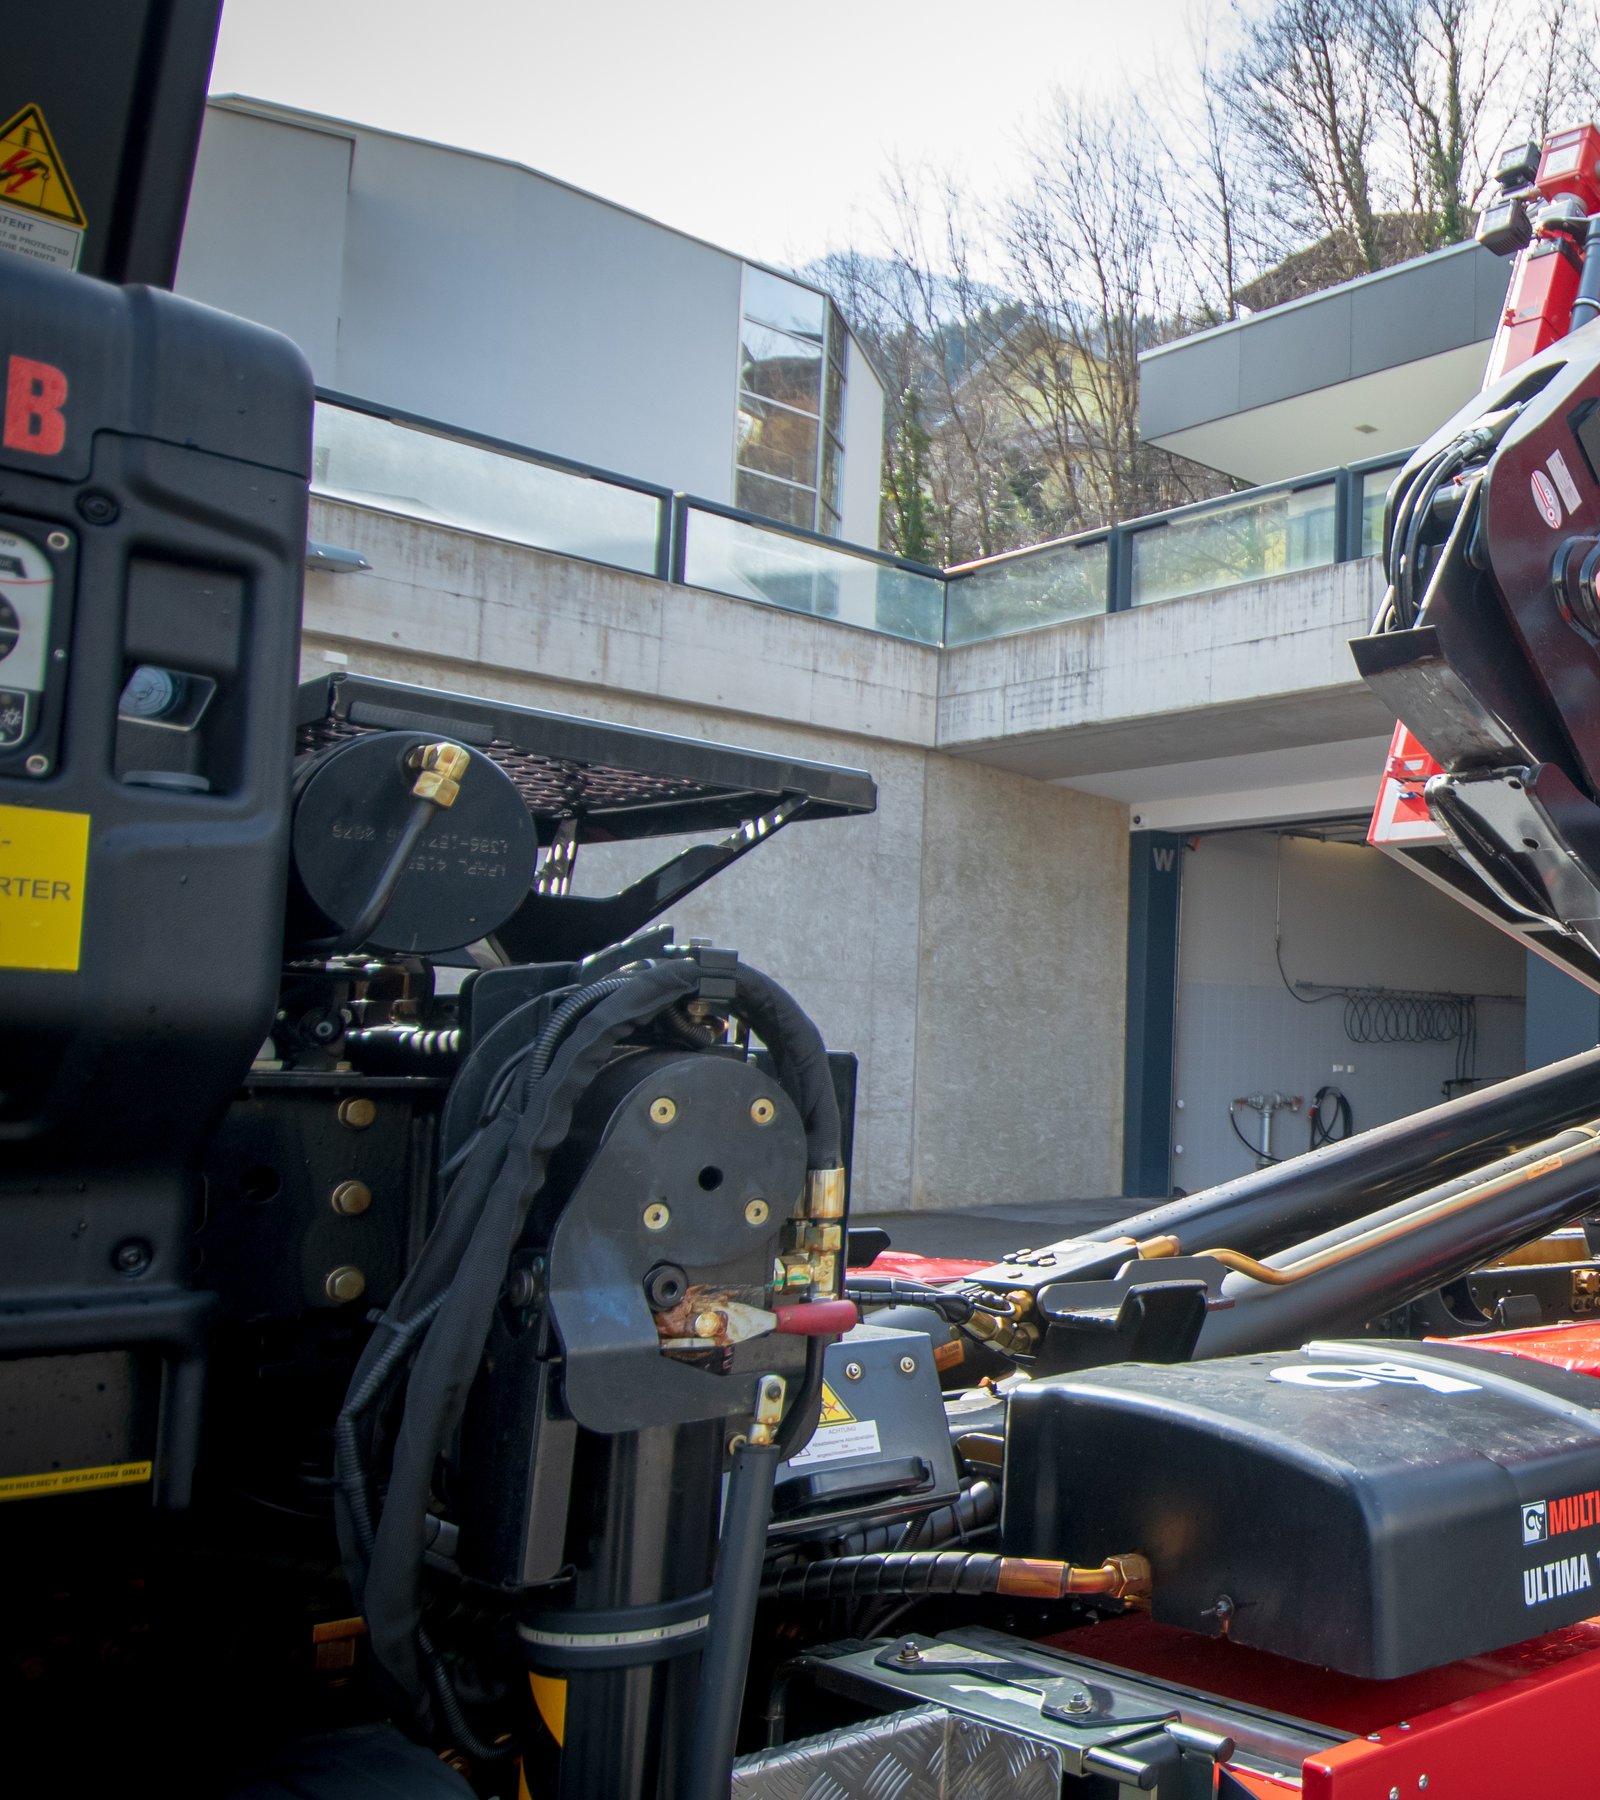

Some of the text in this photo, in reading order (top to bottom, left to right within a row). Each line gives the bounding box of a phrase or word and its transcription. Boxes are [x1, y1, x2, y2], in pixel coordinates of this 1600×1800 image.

[0, 214, 34, 232] TENT
[19, 235, 69, 257] PROTECTED
[3, 354, 68, 456] B
[1152, 847, 1174, 872] W
[828, 1425, 857, 1435] ACHTUNG
[62, 1470, 118, 1484] OPERATION
[122, 1466, 148, 1477] ONLY
[1523, 1553, 1592, 1607] ULTIMA
